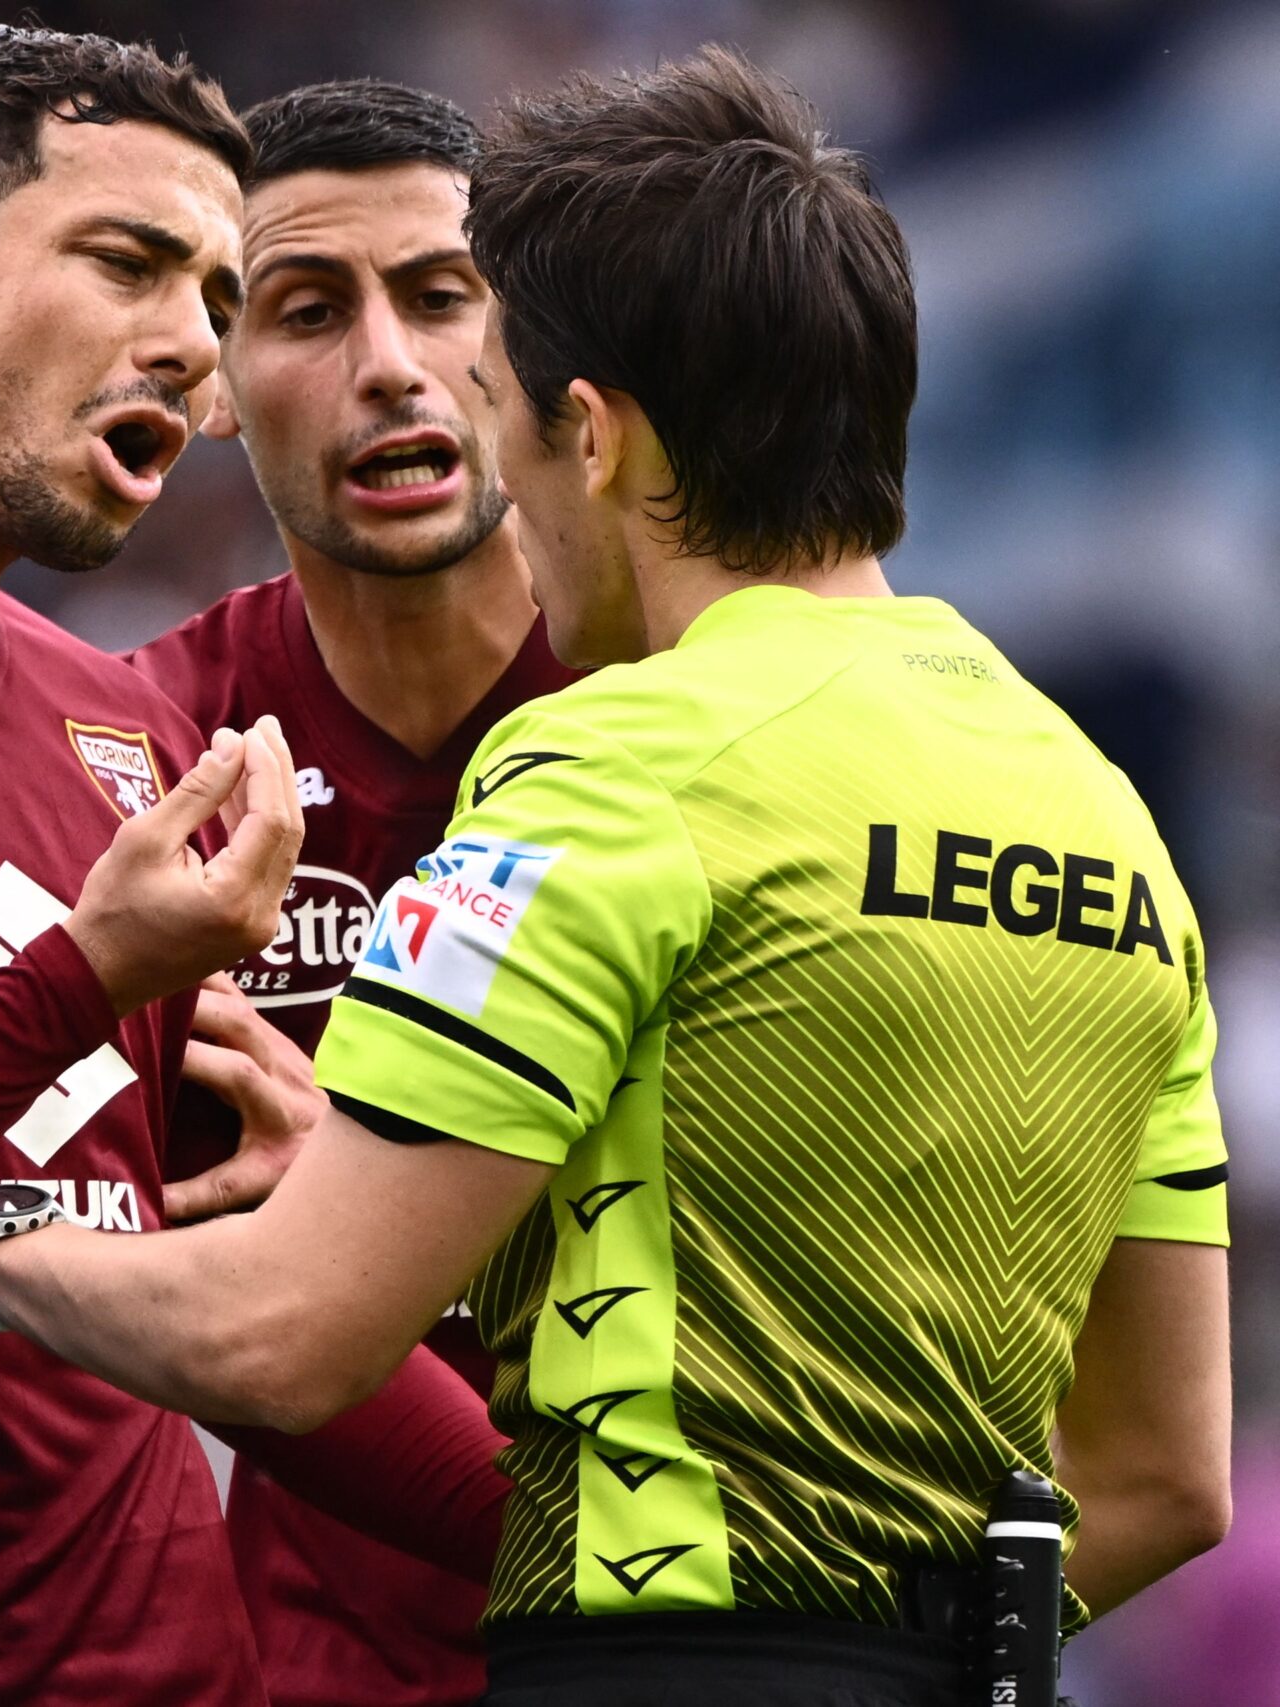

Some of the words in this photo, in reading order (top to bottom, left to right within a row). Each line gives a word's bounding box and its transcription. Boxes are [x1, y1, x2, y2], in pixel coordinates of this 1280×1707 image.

[901, 653, 1001, 685] PRONTERA
[82, 741, 144, 772] TORINO
[860, 824, 1175, 967] LEGEA
[260, 896, 376, 966] etta
[1, 1179, 142, 1232] UKI
